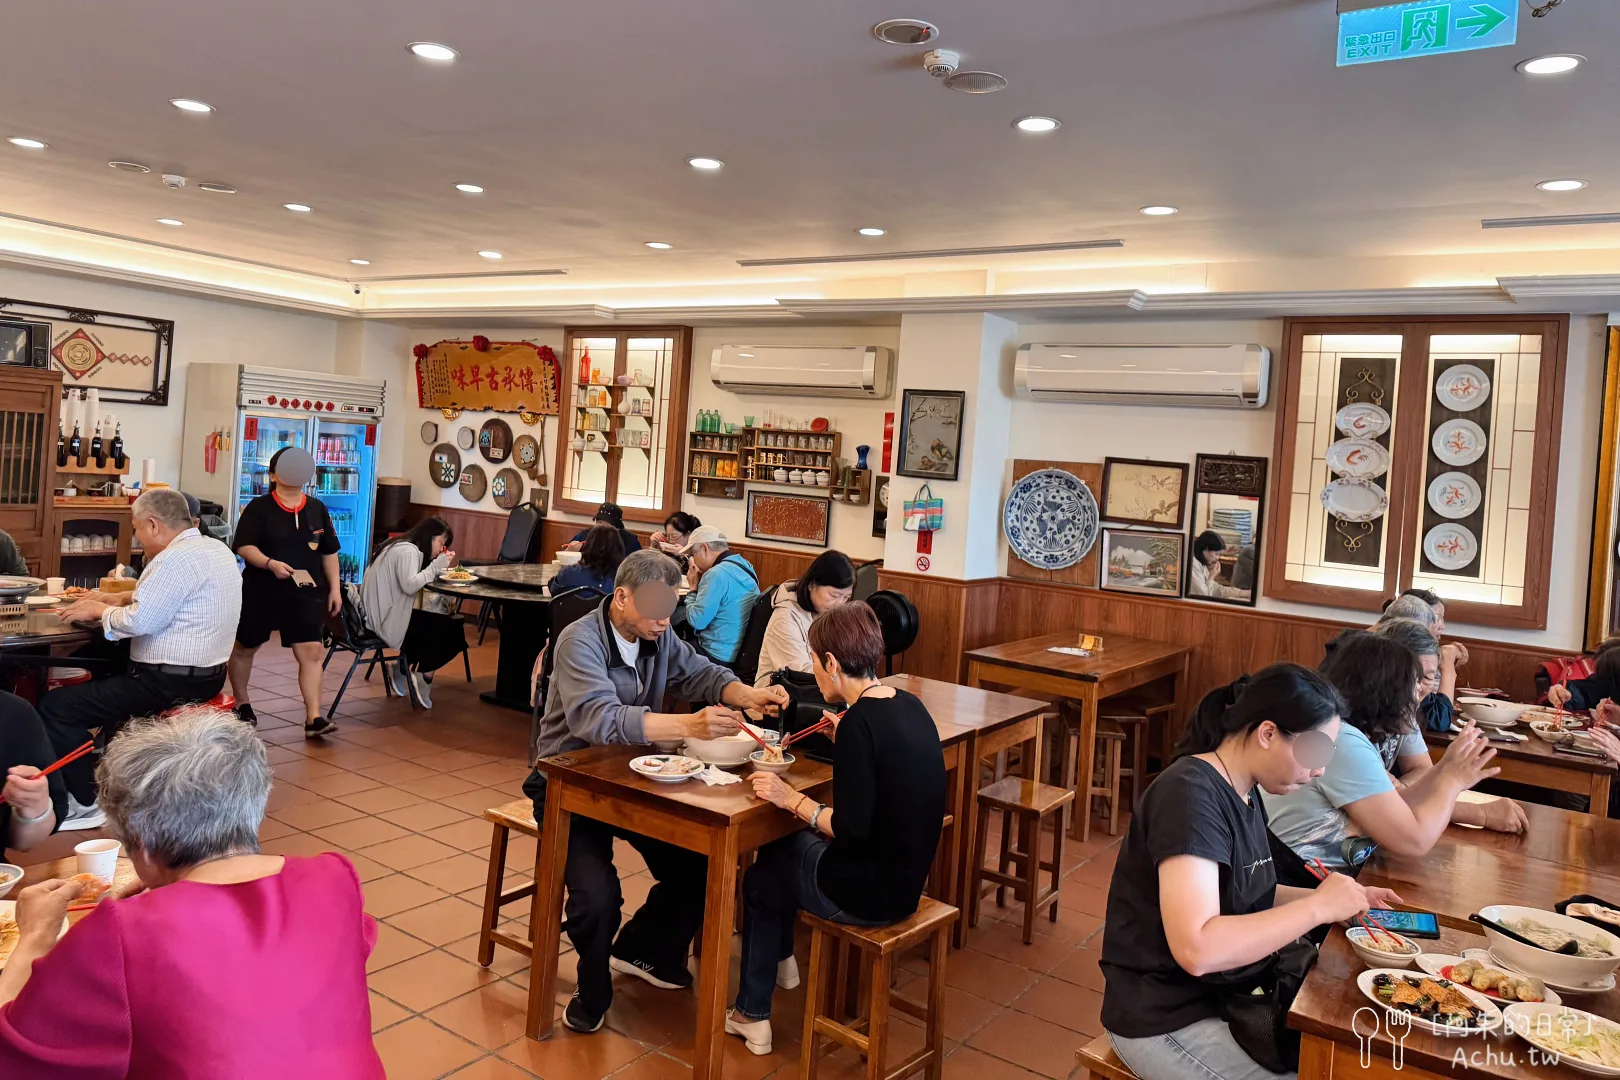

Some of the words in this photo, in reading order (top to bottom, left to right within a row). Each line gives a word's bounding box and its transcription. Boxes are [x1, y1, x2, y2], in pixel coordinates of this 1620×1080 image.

[1345, 31, 1396, 48] 緊急出口
[1347, 44, 1392, 58] EXIT
